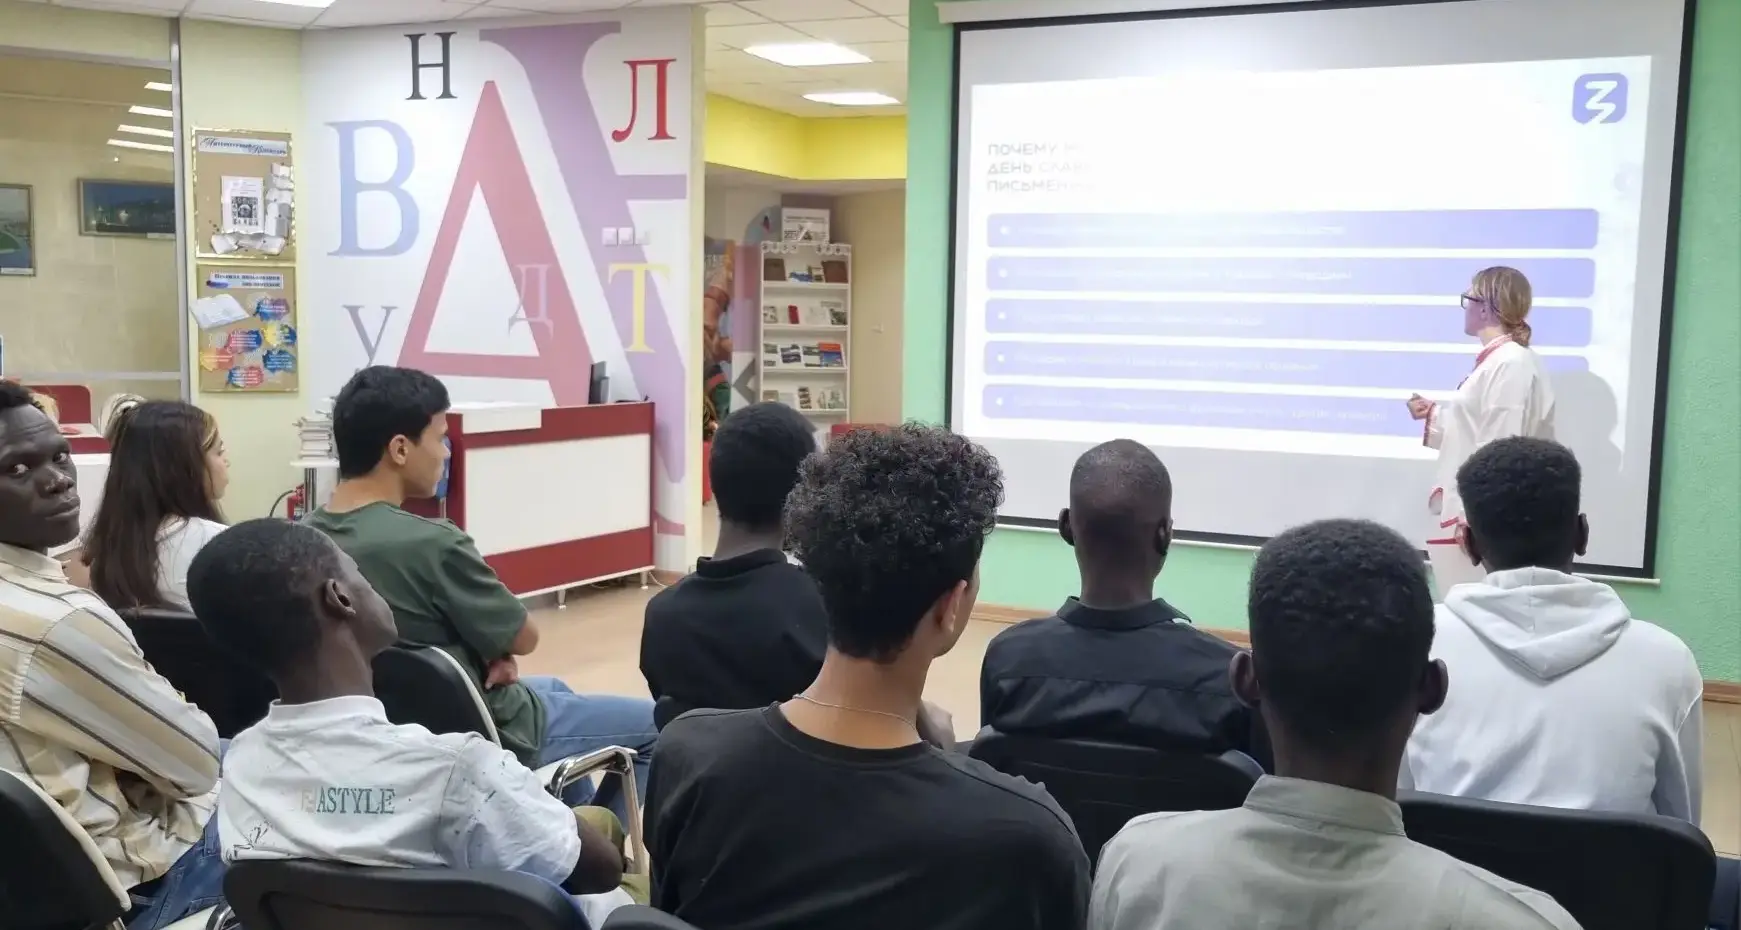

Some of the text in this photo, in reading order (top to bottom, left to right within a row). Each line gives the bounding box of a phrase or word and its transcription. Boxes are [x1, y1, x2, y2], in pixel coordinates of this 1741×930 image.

[404, 31, 458, 100] Н
[611, 58, 677, 142] Л
[988, 142, 1057, 157] ПОЧЕМУ
[988, 161, 1033, 175] ДЕНЬ
[323, 119, 420, 257] В
[508, 264, 554, 338] Д
[608, 263, 670, 354] Т
